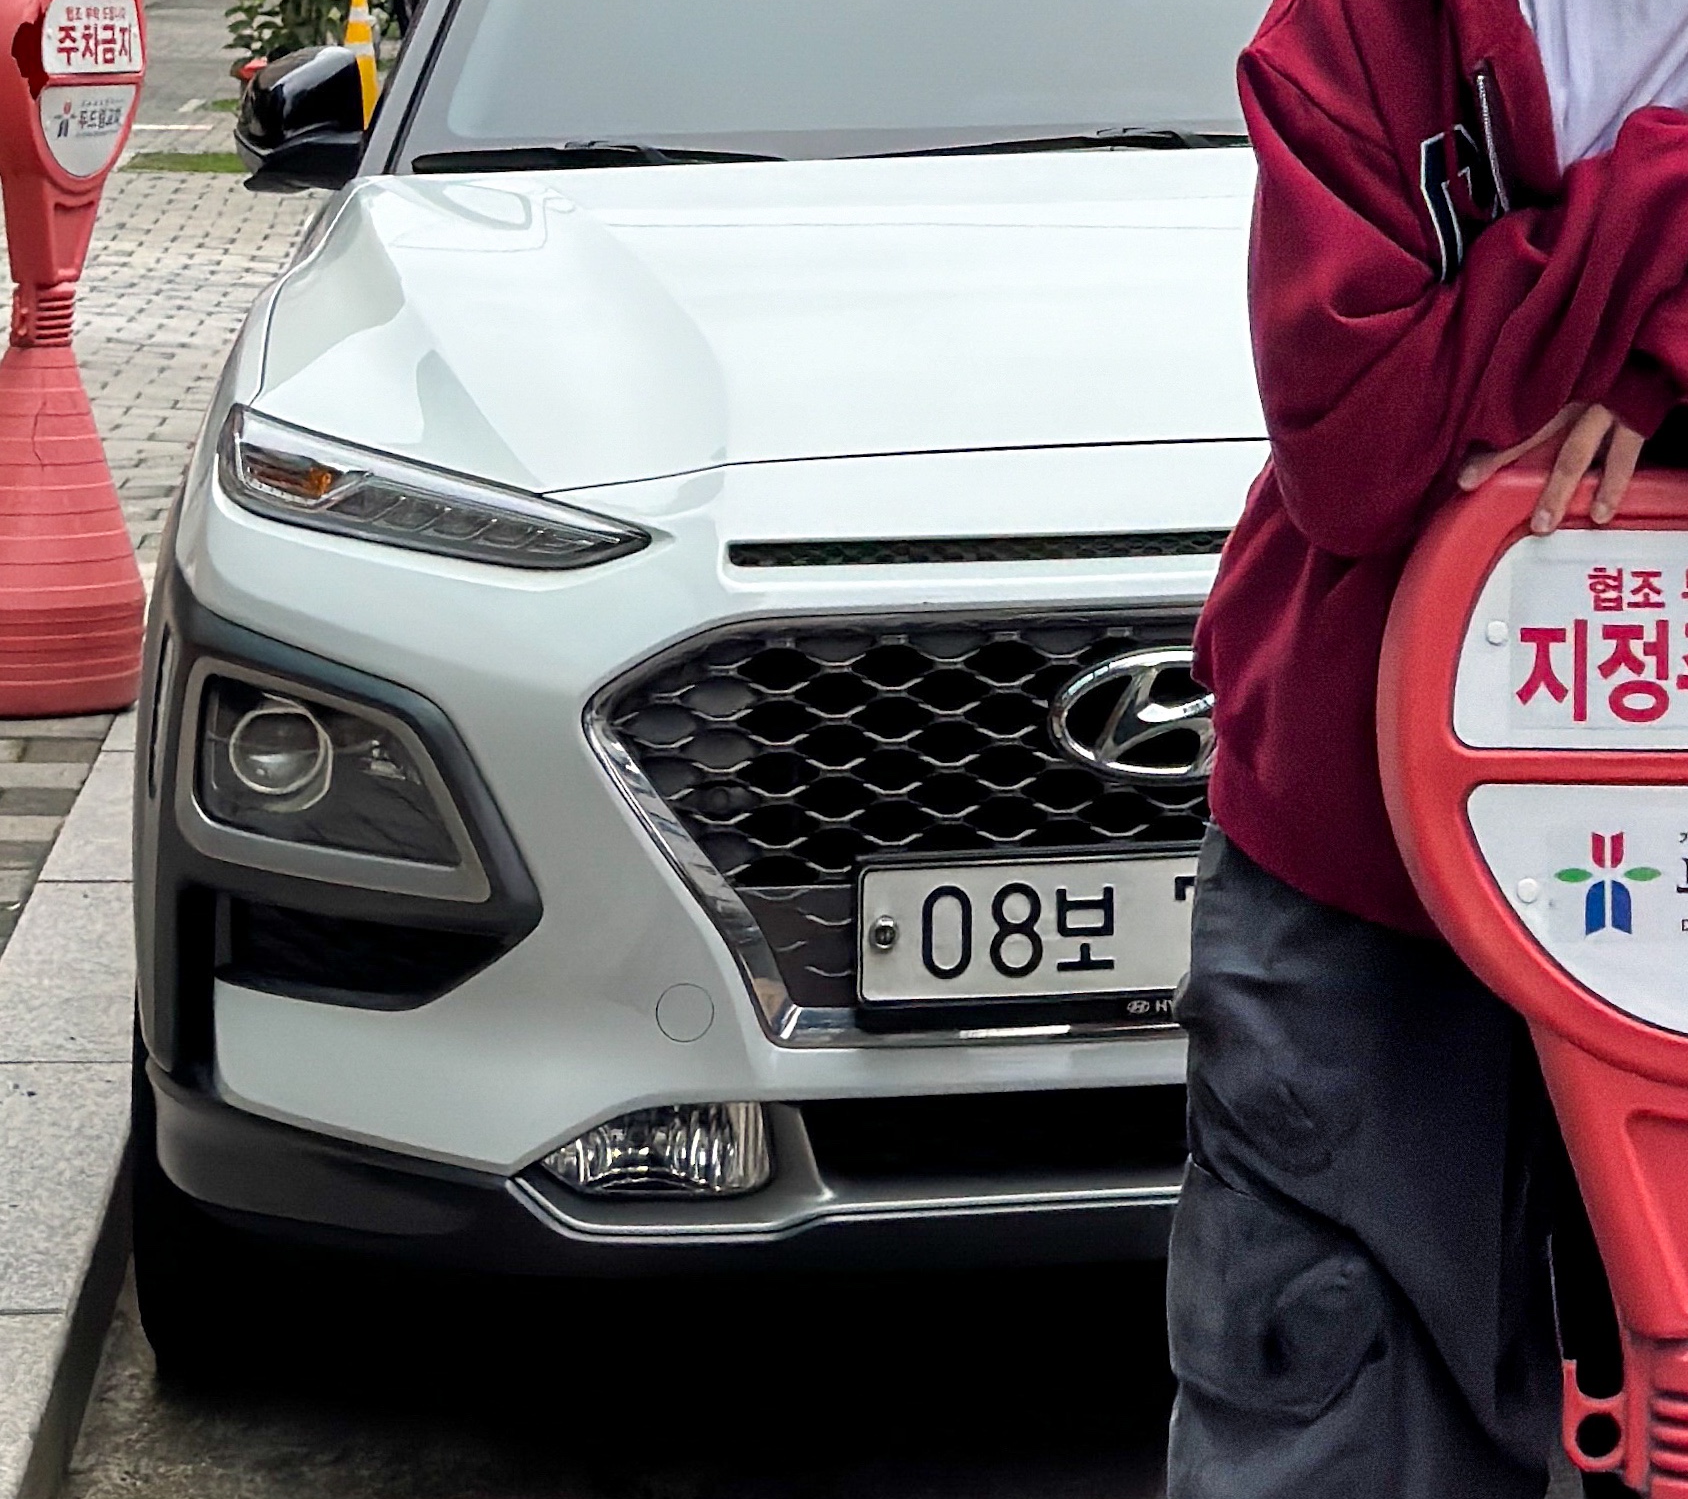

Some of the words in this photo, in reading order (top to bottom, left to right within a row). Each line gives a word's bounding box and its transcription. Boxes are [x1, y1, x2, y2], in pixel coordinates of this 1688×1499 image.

[57, 23, 132, 66] 주차금지
[1587, 566, 1666, 612] 협조
[922, 882, 1115, 980] 08보
